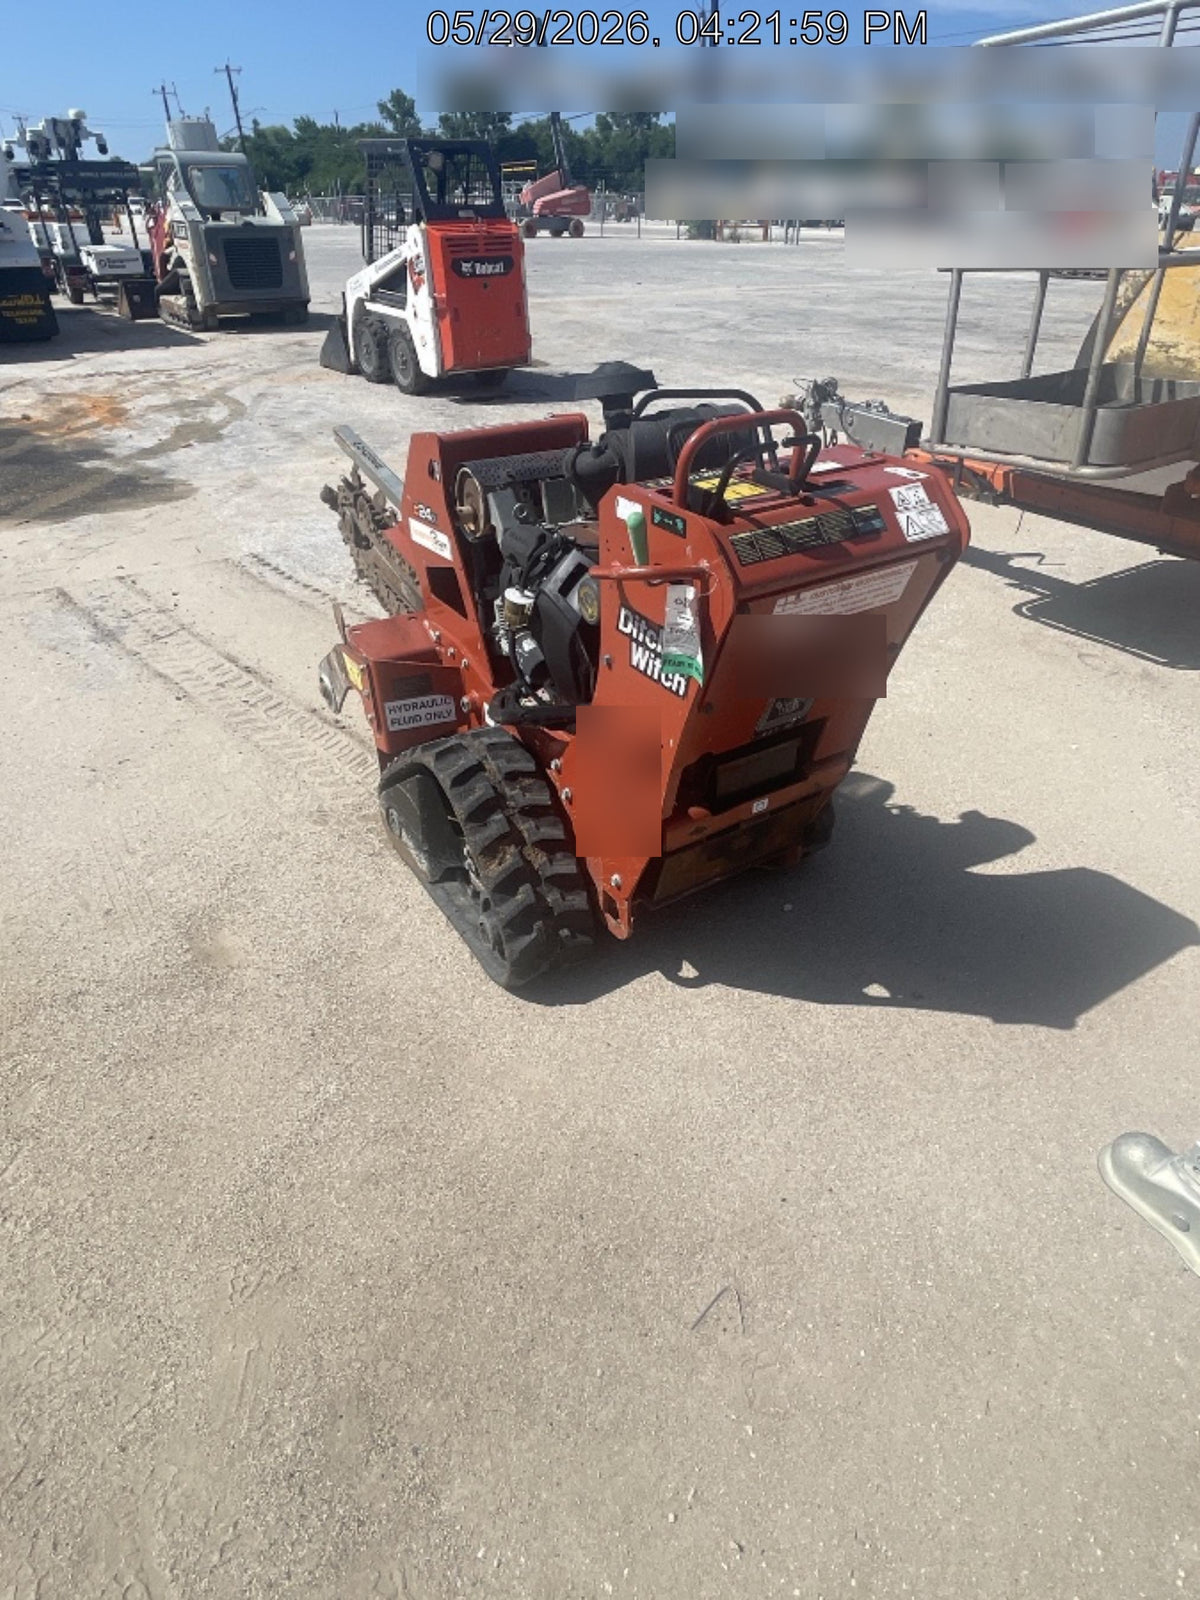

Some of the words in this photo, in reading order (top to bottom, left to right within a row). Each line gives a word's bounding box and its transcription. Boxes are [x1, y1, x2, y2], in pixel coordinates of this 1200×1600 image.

[474, 261, 504, 275] Bobcat
[630, 640, 687, 697] Witch
[388, 697, 452, 715] HYDRAULIC
[390, 714, 422, 727] FLUID
[424, 709, 453, 721] ONLY
